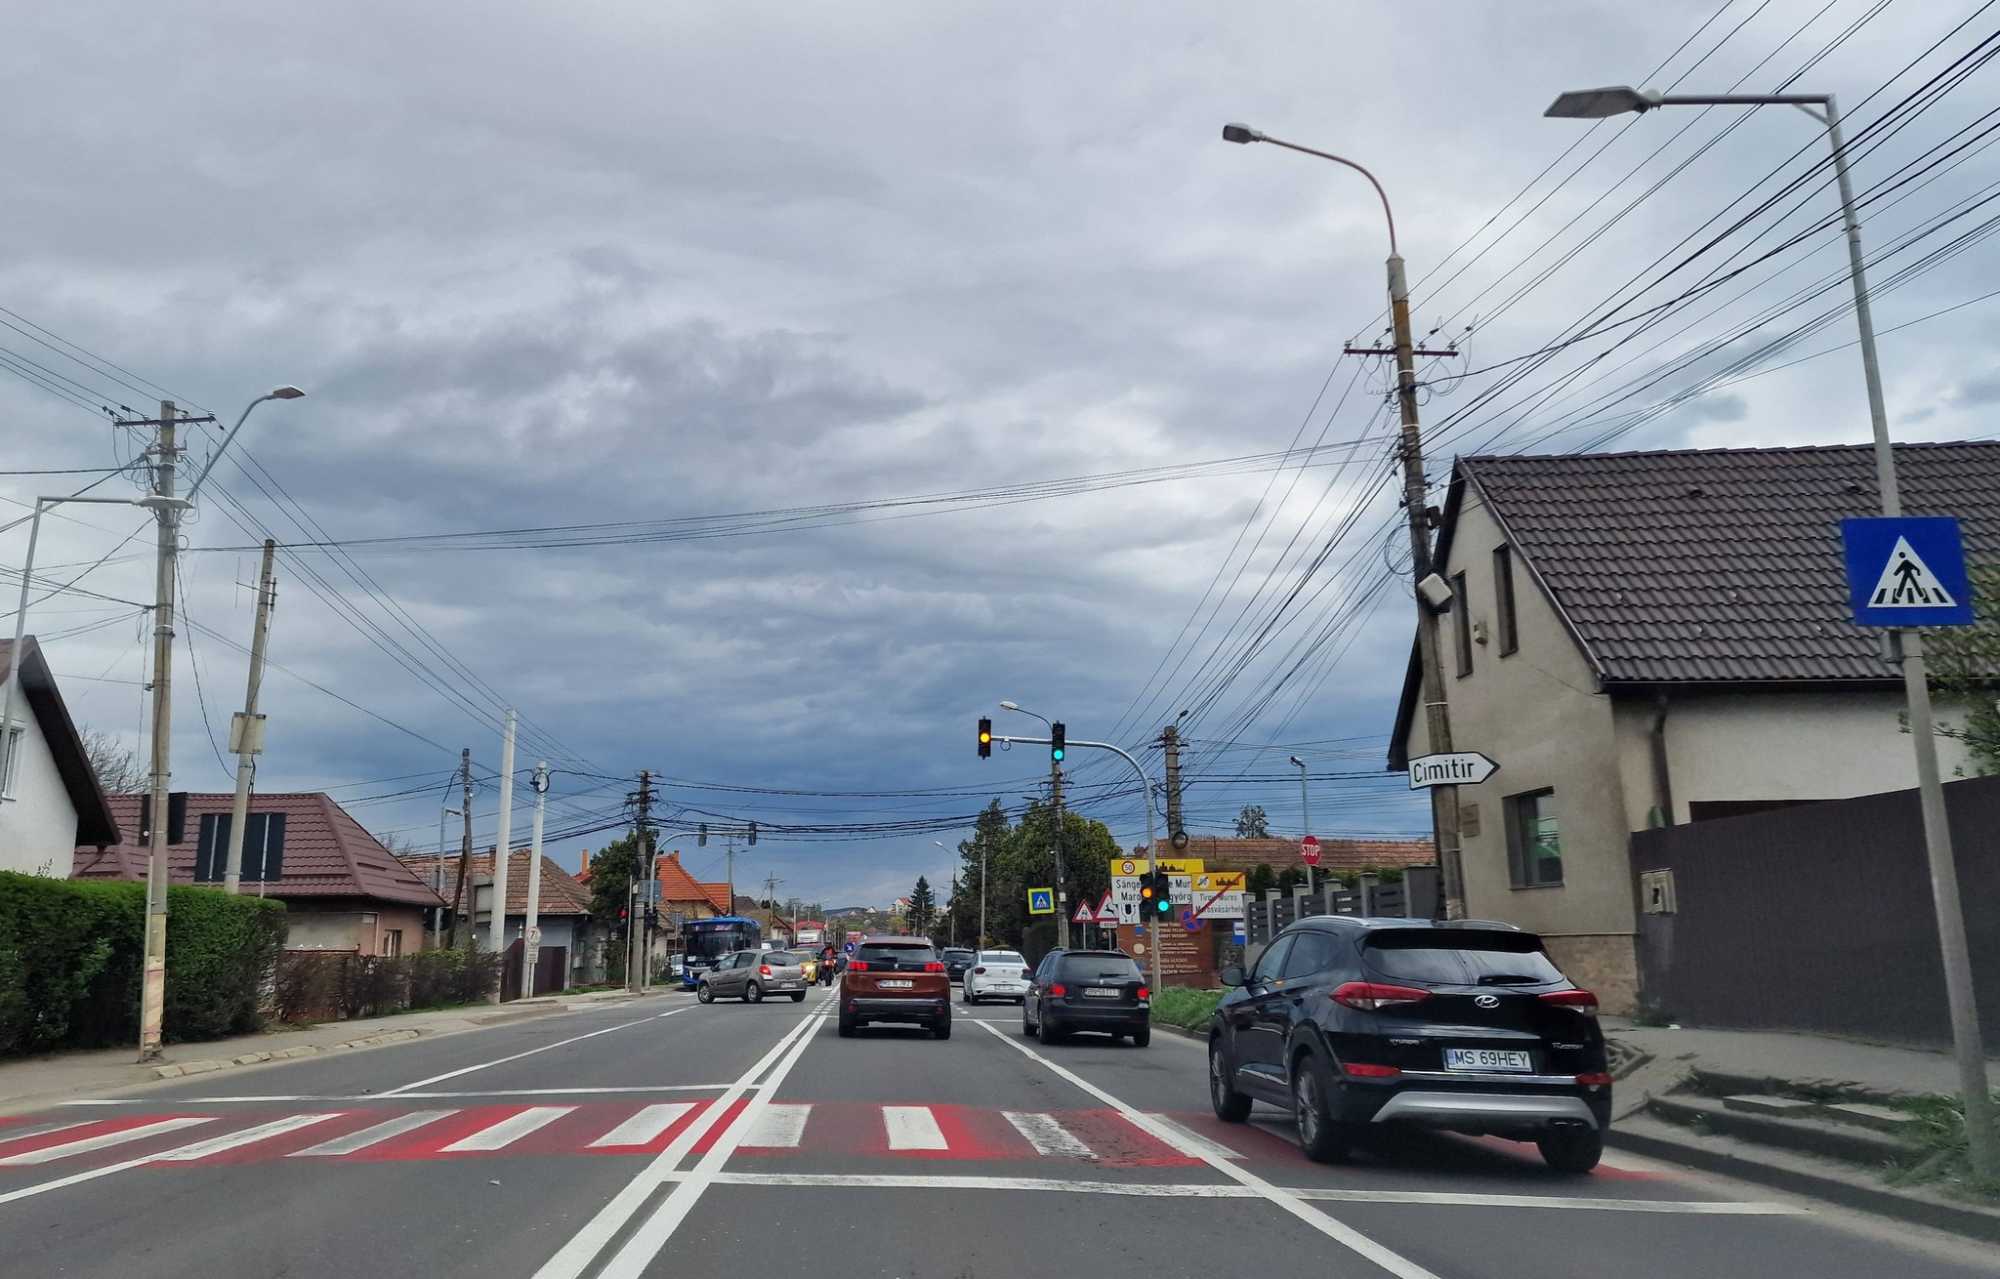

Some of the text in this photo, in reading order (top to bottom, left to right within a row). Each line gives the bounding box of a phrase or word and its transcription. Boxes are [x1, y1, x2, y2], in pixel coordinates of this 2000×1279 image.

[1413, 759, 1475, 783] Cimitir
[1302, 844, 1320, 856] STOP
[1455, 1050, 1528, 1067] MS 69HEY
